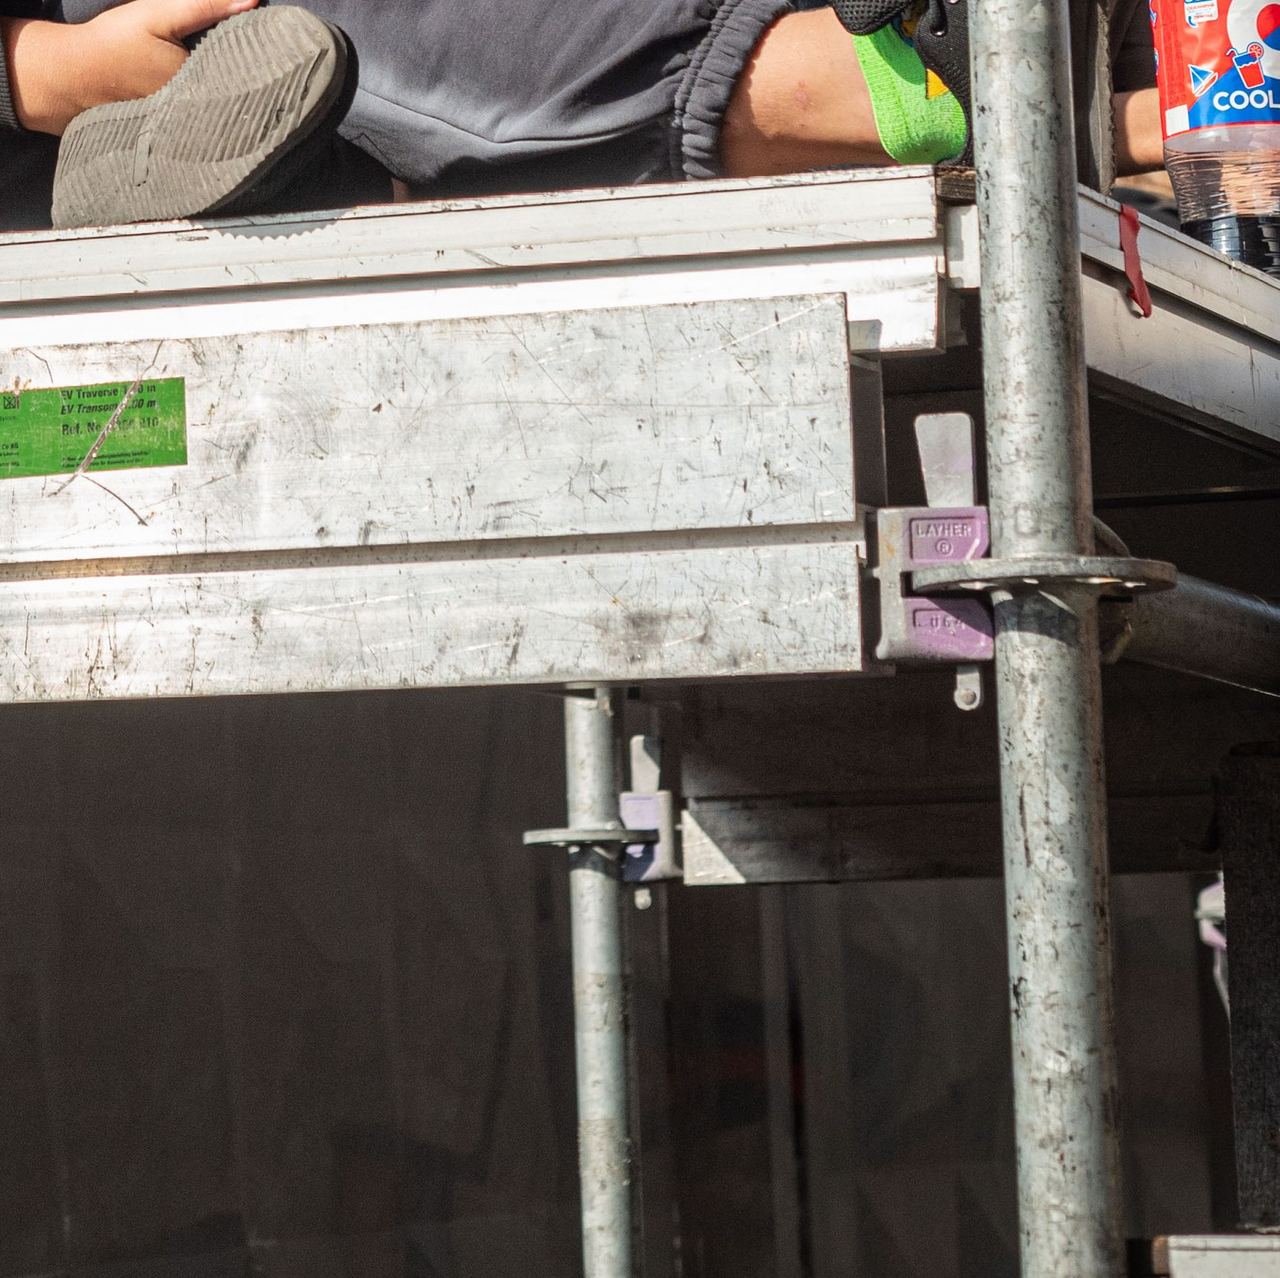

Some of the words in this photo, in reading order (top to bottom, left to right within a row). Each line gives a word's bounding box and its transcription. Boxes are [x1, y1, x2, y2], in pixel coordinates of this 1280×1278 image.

[76, 386, 118, 399] Traverse
[60, 404, 74, 415] EV
[77, 402, 119, 414] Transom
[146, 399, 156, 407] m
[916, 521, 972, 537] LAYHER
